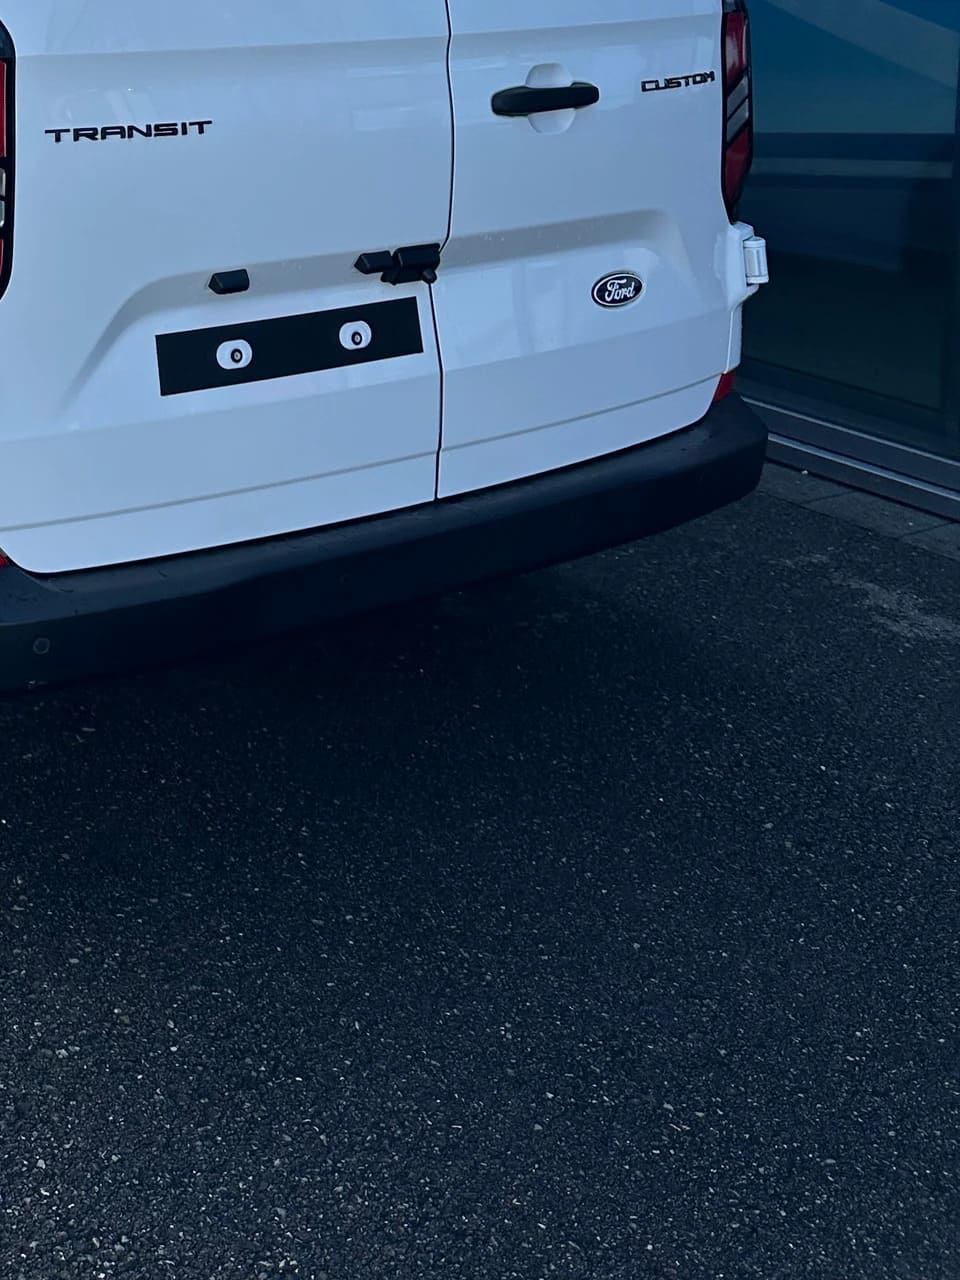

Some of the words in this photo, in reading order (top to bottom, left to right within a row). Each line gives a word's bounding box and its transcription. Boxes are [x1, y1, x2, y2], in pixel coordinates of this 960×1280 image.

[641, 70, 715, 92] CUSTOM
[44, 120, 213, 143] TRANSIT
[604, 278, 636, 302] Ford
